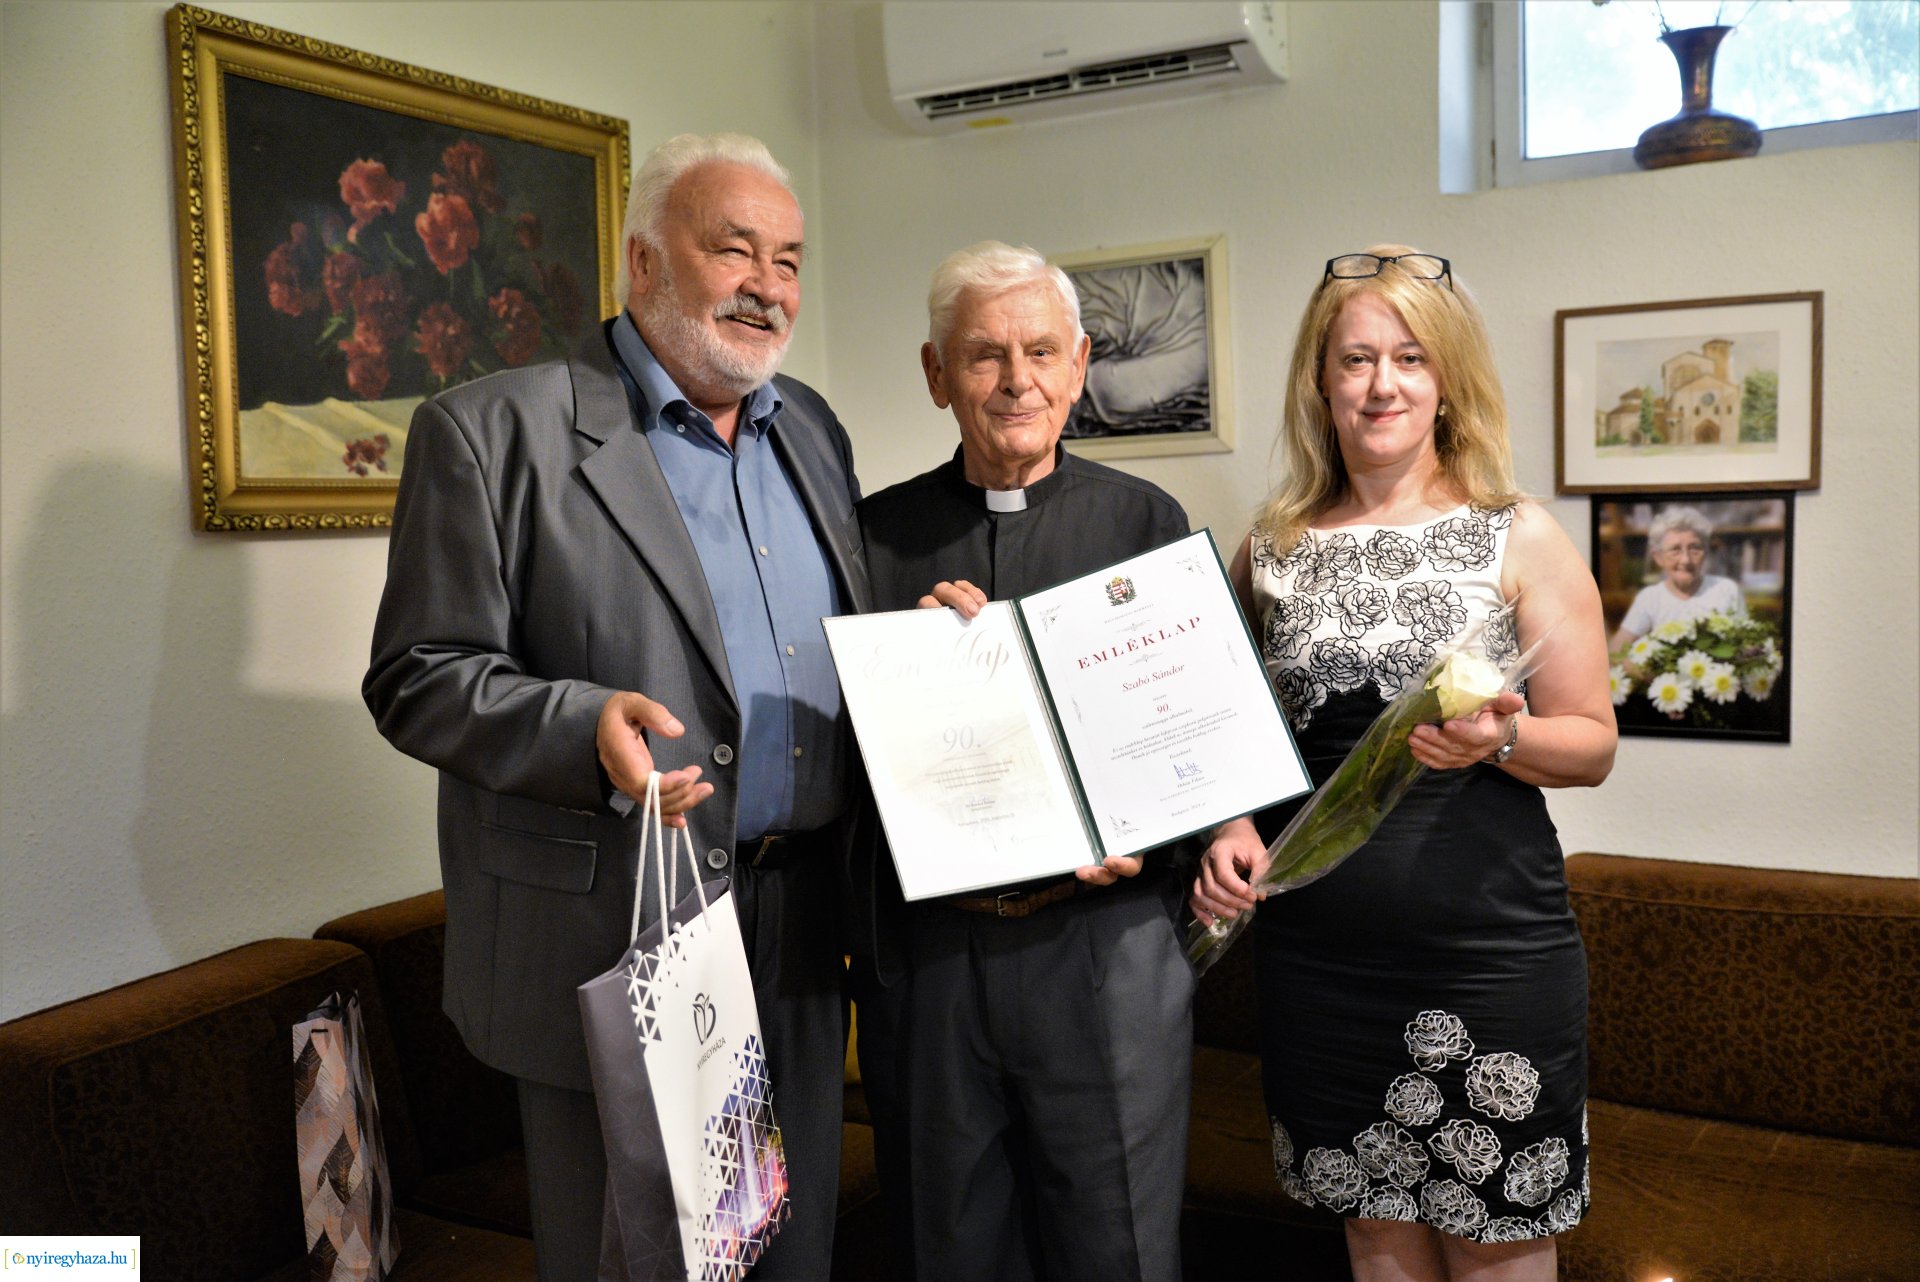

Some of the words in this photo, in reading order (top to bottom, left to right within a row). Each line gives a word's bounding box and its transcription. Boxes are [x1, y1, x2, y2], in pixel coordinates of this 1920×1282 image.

[1078, 616, 1200, 669] EMLÉKLAP
[1122, 676, 1150, 692] Szabó
[1152, 664, 1185, 682] Sándor
[1156, 703, 1172, 714] 90.
[943, 726, 981, 752] 90.
[696, 1036, 726, 1071] NYÍREGYHÁZA
